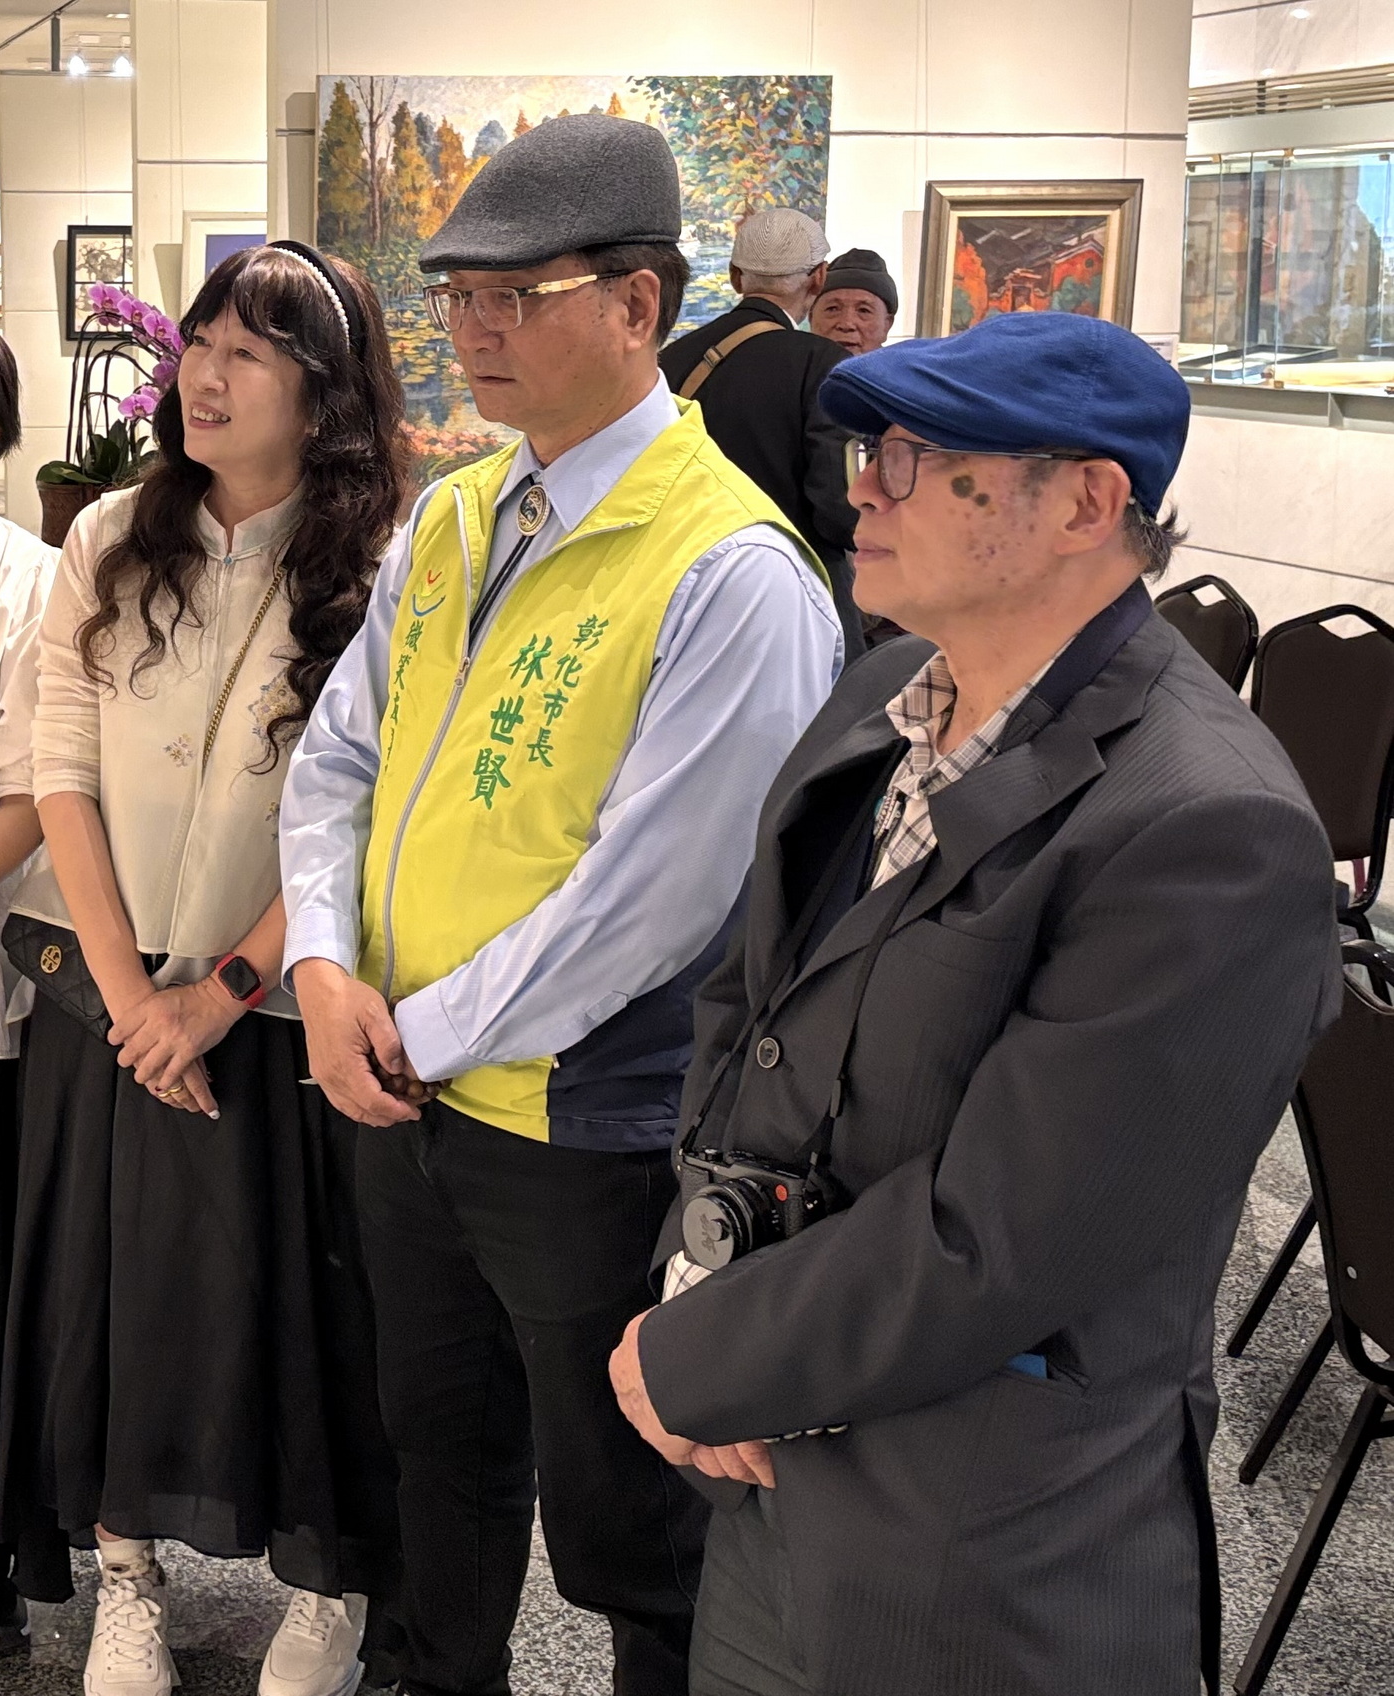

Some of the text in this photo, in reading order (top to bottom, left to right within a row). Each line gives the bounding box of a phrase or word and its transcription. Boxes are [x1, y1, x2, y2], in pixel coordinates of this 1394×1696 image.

[469, 633, 552, 810] 林世賢
[527, 614, 610, 768] 彰化市長
